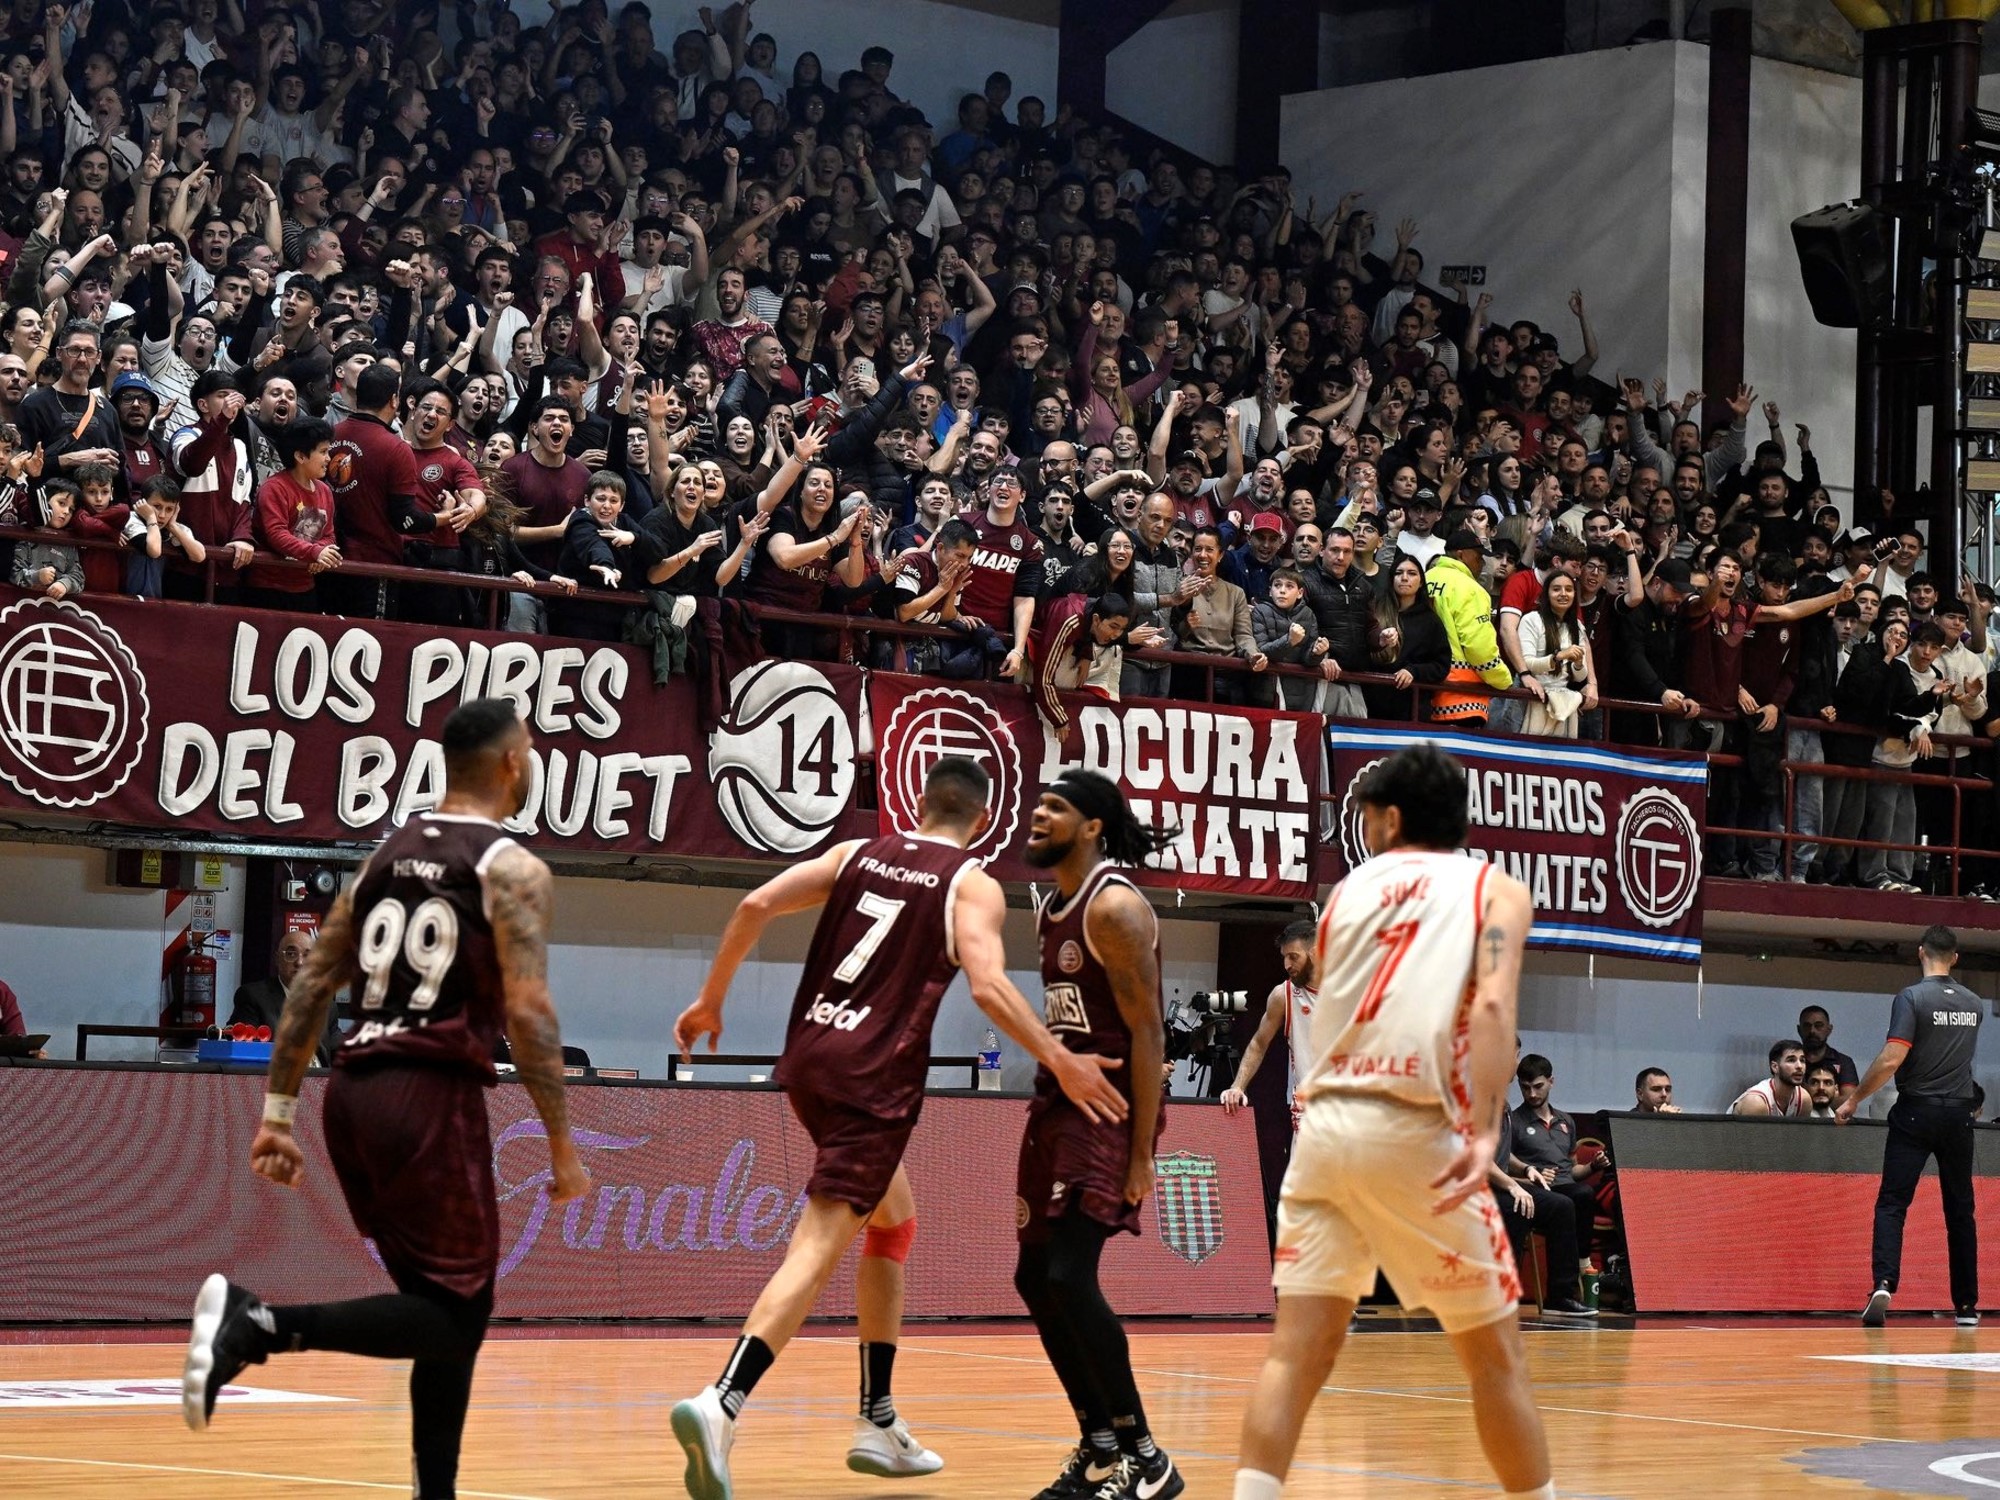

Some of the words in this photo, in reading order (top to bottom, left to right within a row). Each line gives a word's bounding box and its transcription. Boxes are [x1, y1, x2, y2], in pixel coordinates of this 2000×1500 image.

[135, 450, 150, 462] 10
[230, 620, 382, 723] LOS
[406, 637, 629, 739] PIBES
[158, 721, 304, 824] DEL
[338, 734, 692, 842] BAQUET
[776, 713, 839, 797] 14
[1038, 702, 1309, 803] LOCURA
[1463, 767, 1607, 837] ACHEROS
[393, 859, 447, 881] HENRY
[857, 856, 939, 888] FRANCHINO
[359, 897, 459, 1010] 99
[833, 890, 907, 984] 7
[1354, 920, 1421, 1024] 7
[1932, 1010, 1949, 1026] SAN
[1949, 1010, 1978, 1027] ISIDRO
